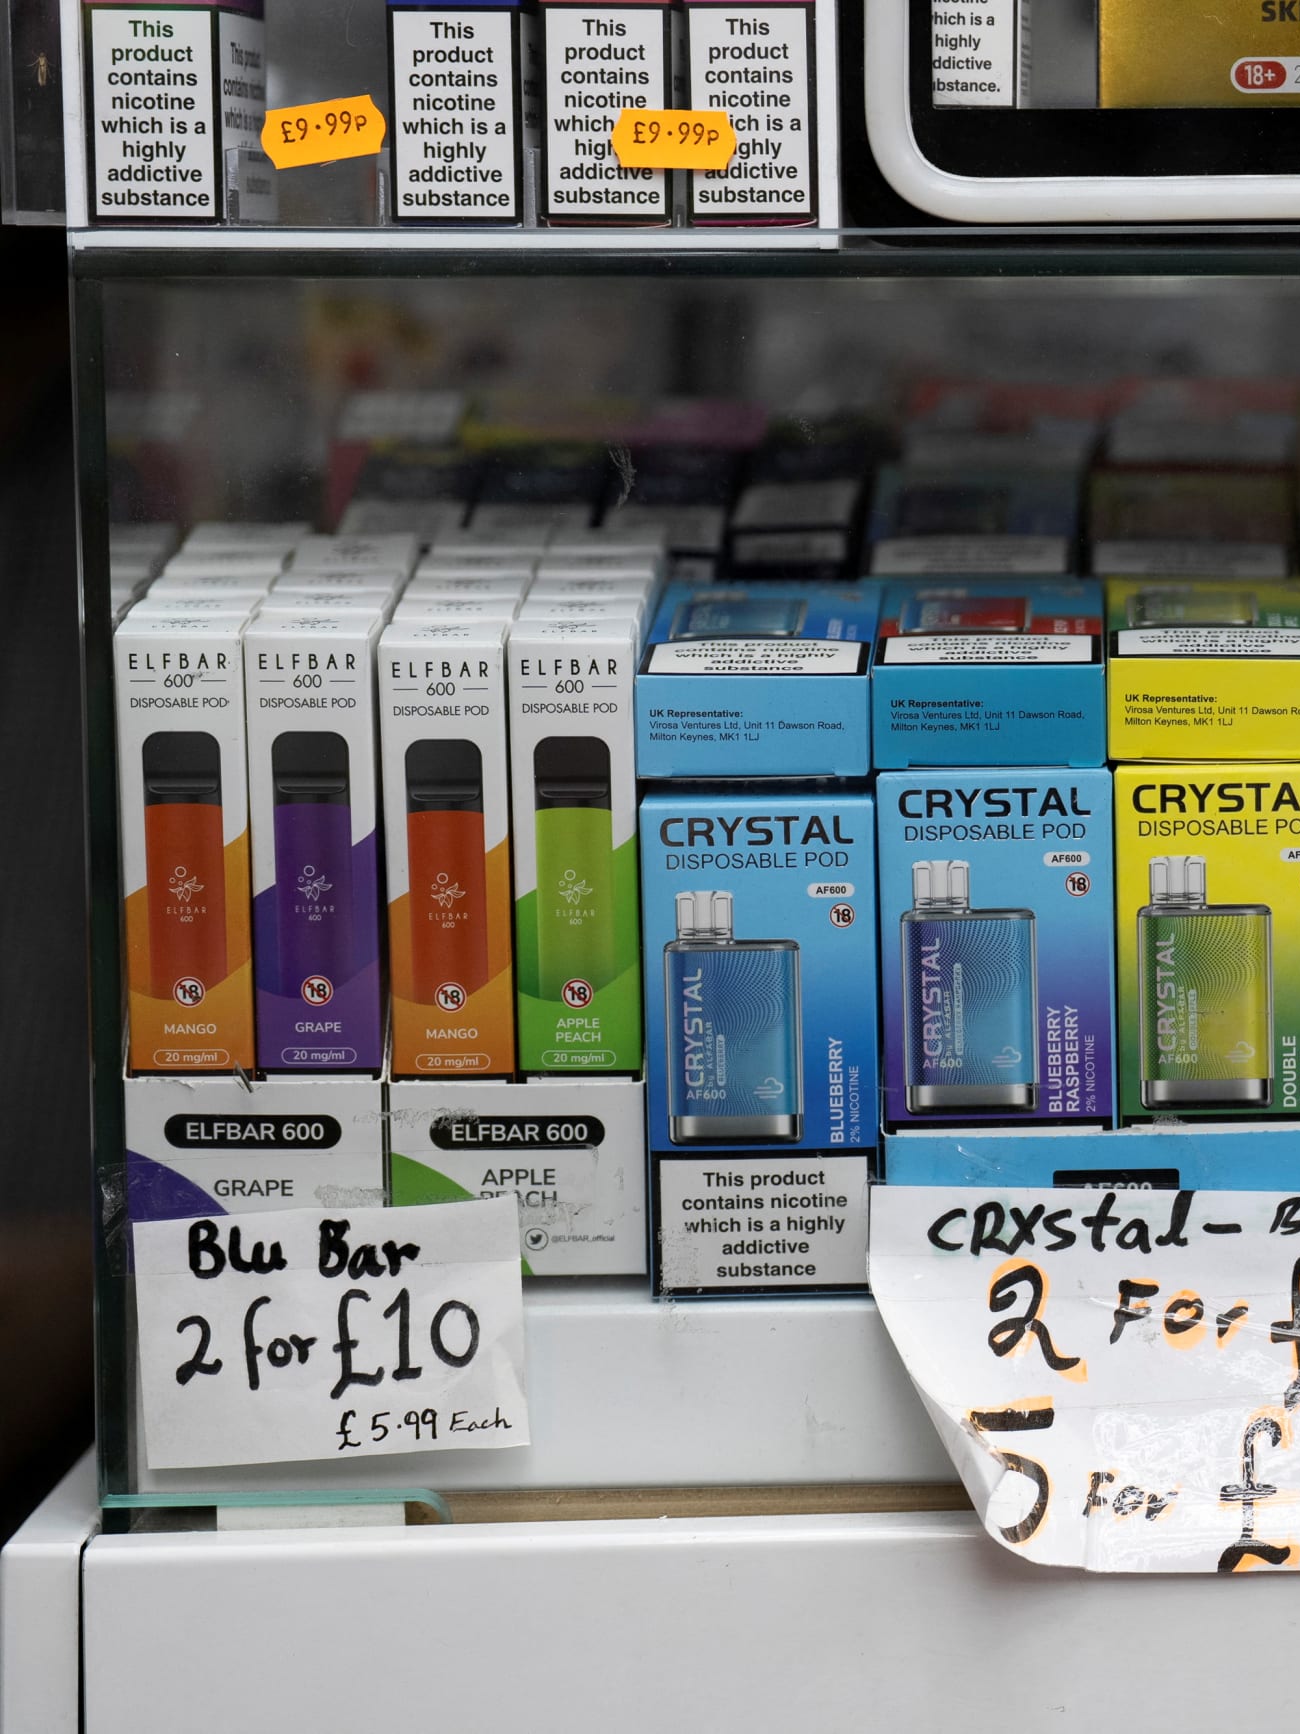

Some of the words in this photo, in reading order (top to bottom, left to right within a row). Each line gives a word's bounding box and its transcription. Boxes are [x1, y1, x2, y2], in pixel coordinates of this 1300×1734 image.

[128, 20, 173, 37] This
[935, 34, 980, 51] highly
[112, 46, 192, 65] product
[108, 70, 197, 86] contains
[1244, 65, 1275, 85] 18+
[112, 94, 195, 110] nicotine
[102, 118, 163, 134] which
[170, 118, 187, 134] is
[194, 121, 206, 134] a
[122, 142, 186, 162] highly
[107, 166, 202, 181] addictive
[102, 190, 209, 207] substance
[129, 653, 226, 669] ELFBAR
[259, 654, 355, 669] ELFBAR
[522, 659, 617, 675] ELFBAR
[392, 661, 488, 678] ELFBAR
[164, 674, 193, 687] 600
[293, 674, 322, 688] 600
[556, 680, 584, 693] 600
[426, 682, 455, 696] 600
[130, 698, 199, 708] DISPOSABLE
[203, 698, 228, 708] POD
[260, 698, 327, 708] DISPOSABLE
[332, 698, 356, 708] POD
[394, 706, 460, 716] DISPOSABLE
[465, 706, 489, 715] POD
[522, 703, 589, 713] DISPOSABLE
[593, 703, 617, 713] POD
[668, 710, 743, 718] Representative:
[650, 721, 678, 729] Virosa
[682, 721, 721, 729] Ventures
[724, 721, 740, 730] Ltd,
[744, 721, 761, 729] Unit
[766, 721, 774, 729] 11
[779, 721, 814, 729] Dawson
[818, 721, 844, 730] Road,
[650, 733, 676, 741] Milton
[680, 733, 716, 742] Keynes,
[720, 733, 739, 741] MK1
[744, 733, 759, 741] 1LJ
[898, 787, 1091, 818] CRYSTAL
[660, 816, 853, 847] CRYSTAL
[905, 824, 1034, 841] DISPOSABLE
[1043, 824, 1086, 839] POD
[1139, 820, 1268, 836] DISPOSABLE
[667, 853, 797, 870] DISPOSABLE
[805, 852, 848, 867] POD
[1052, 855, 1082, 863] AF600
[816, 886, 846, 894] AF600
[164, 1024, 216, 1034] MANGO
[295, 1022, 341, 1033] GRAPE
[557, 1018, 600, 1029] APPLE
[426, 1029, 478, 1039] MANGO
[556, 1032, 601, 1042] PEACH
[166, 1053, 179, 1062] 20
[183, 1052, 217, 1064] mg/ml
[553, 1054, 567, 1063] 20
[571, 1054, 604, 1065] mg/ml
[1047, 1007, 1062, 1112] BLUEBERRY
[1065, 1006, 1080, 1112] RASPBERRY
[1283, 1035, 1297, 1108] DOUBLE
[829, 1037, 844, 1143] BLUEBERRY
[849, 1066, 860, 1121] NICOTINE
[186, 1122, 276, 1141] ELFBAR
[282, 1123, 324, 1141] 600
[451, 1124, 540, 1142] ELFBAR
[546, 1124, 587, 1141] 600
[850, 1125, 861, 1142] 2%
[481, 1169, 555, 1185] APPLE
[703, 1172, 744, 1187] This
[751, 1171, 825, 1190] product
[214, 1179, 293, 1197] GRAPE
[682, 1195, 764, 1210] contains
[771, 1193, 847, 1208] nicotine
[685, 1218, 740, 1233] which
[748, 1217, 763, 1232] is
[770, 1219, 780, 1231] a
[787, 1216, 845, 1234] highly
[188, 1219, 287, 1279] Blu
[318, 1219, 420, 1279] Bar
[723, 1240, 809, 1255] addictive
[717, 1262, 816, 1277] substance
[176, 1316, 222, 1385] 2
[330, 1288, 480, 1399] £10
[450, 1407, 512, 1431] Each
